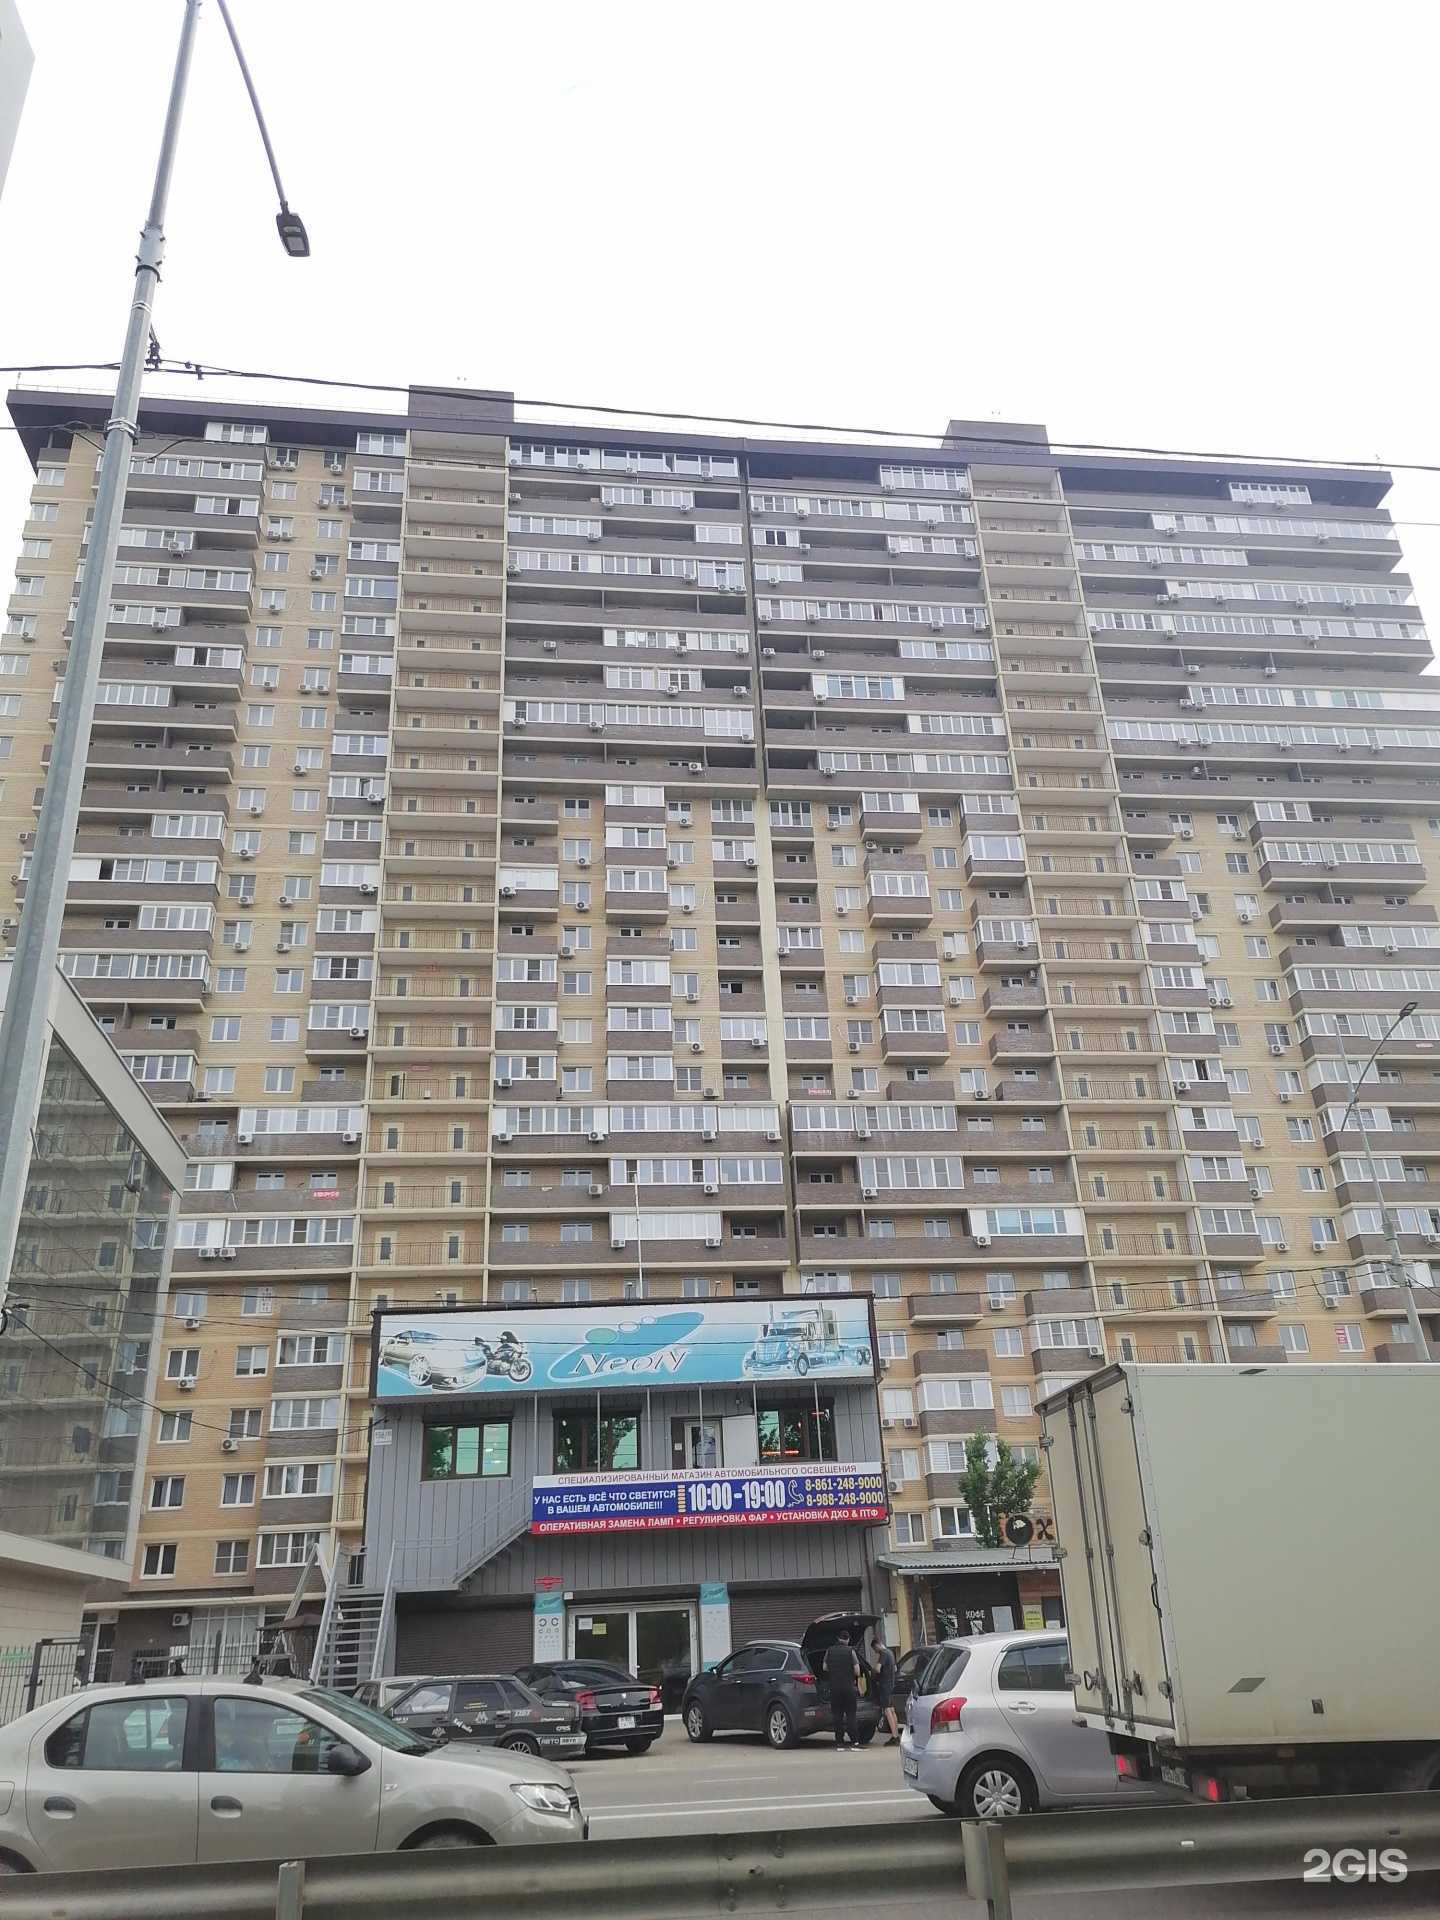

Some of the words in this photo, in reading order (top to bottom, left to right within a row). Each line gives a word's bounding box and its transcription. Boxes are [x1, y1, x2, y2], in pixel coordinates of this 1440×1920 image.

[558, 1472, 670, 1485] СПЕЦИАЛИЗИРОВАННЫЙ
[671, 1470, 712, 1480] МАГАЗИН
[714, 1466, 798, 1478] АВТОМОБИЛЬНОГО
[800, 1464, 857, 1475] ОСВЕЩЕНИЯ
[805, 1476, 882, 1491] 8-861-248-9000
[534, 1496, 540, 1505] У
[542, 1495, 563, 1504] НАС
[565, 1494, 587, 1503] ЕСТЬ
[588, 1491, 607, 1502] ВСЁ
[609, 1492, 628, 1501] ЧТО
[630, 1490, 676, 1500] СВЕТИТСЯ
[806, 1491, 883, 1506] 8-988-248-9000
[547, 1506, 554, 1514] В
[556, 1504, 591, 1514] ВАШЕМ
[592, 1501, 663, 1513] АВТОМОБИЛЕ!!!
[539, 1520, 607, 1532] ОПЕРАТИВНАЯ
[609, 1518, 646, 1529] ЗАМЕНА
[648, 1517, 674, 1527] ЛАМП
[682, 1513, 747, 1525] РЕГУЛИРОВКА
[748, 1513, 767, 1522] ФАР
[776, 1511, 828, 1521] УСТАНОВКА
[830, 1510, 849, 1520] ДХО
[851, 1509, 858, 1518] &
[860, 1508, 879, 1518] ПТФ
[965, 1609, 986, 1619] КОФЕ
